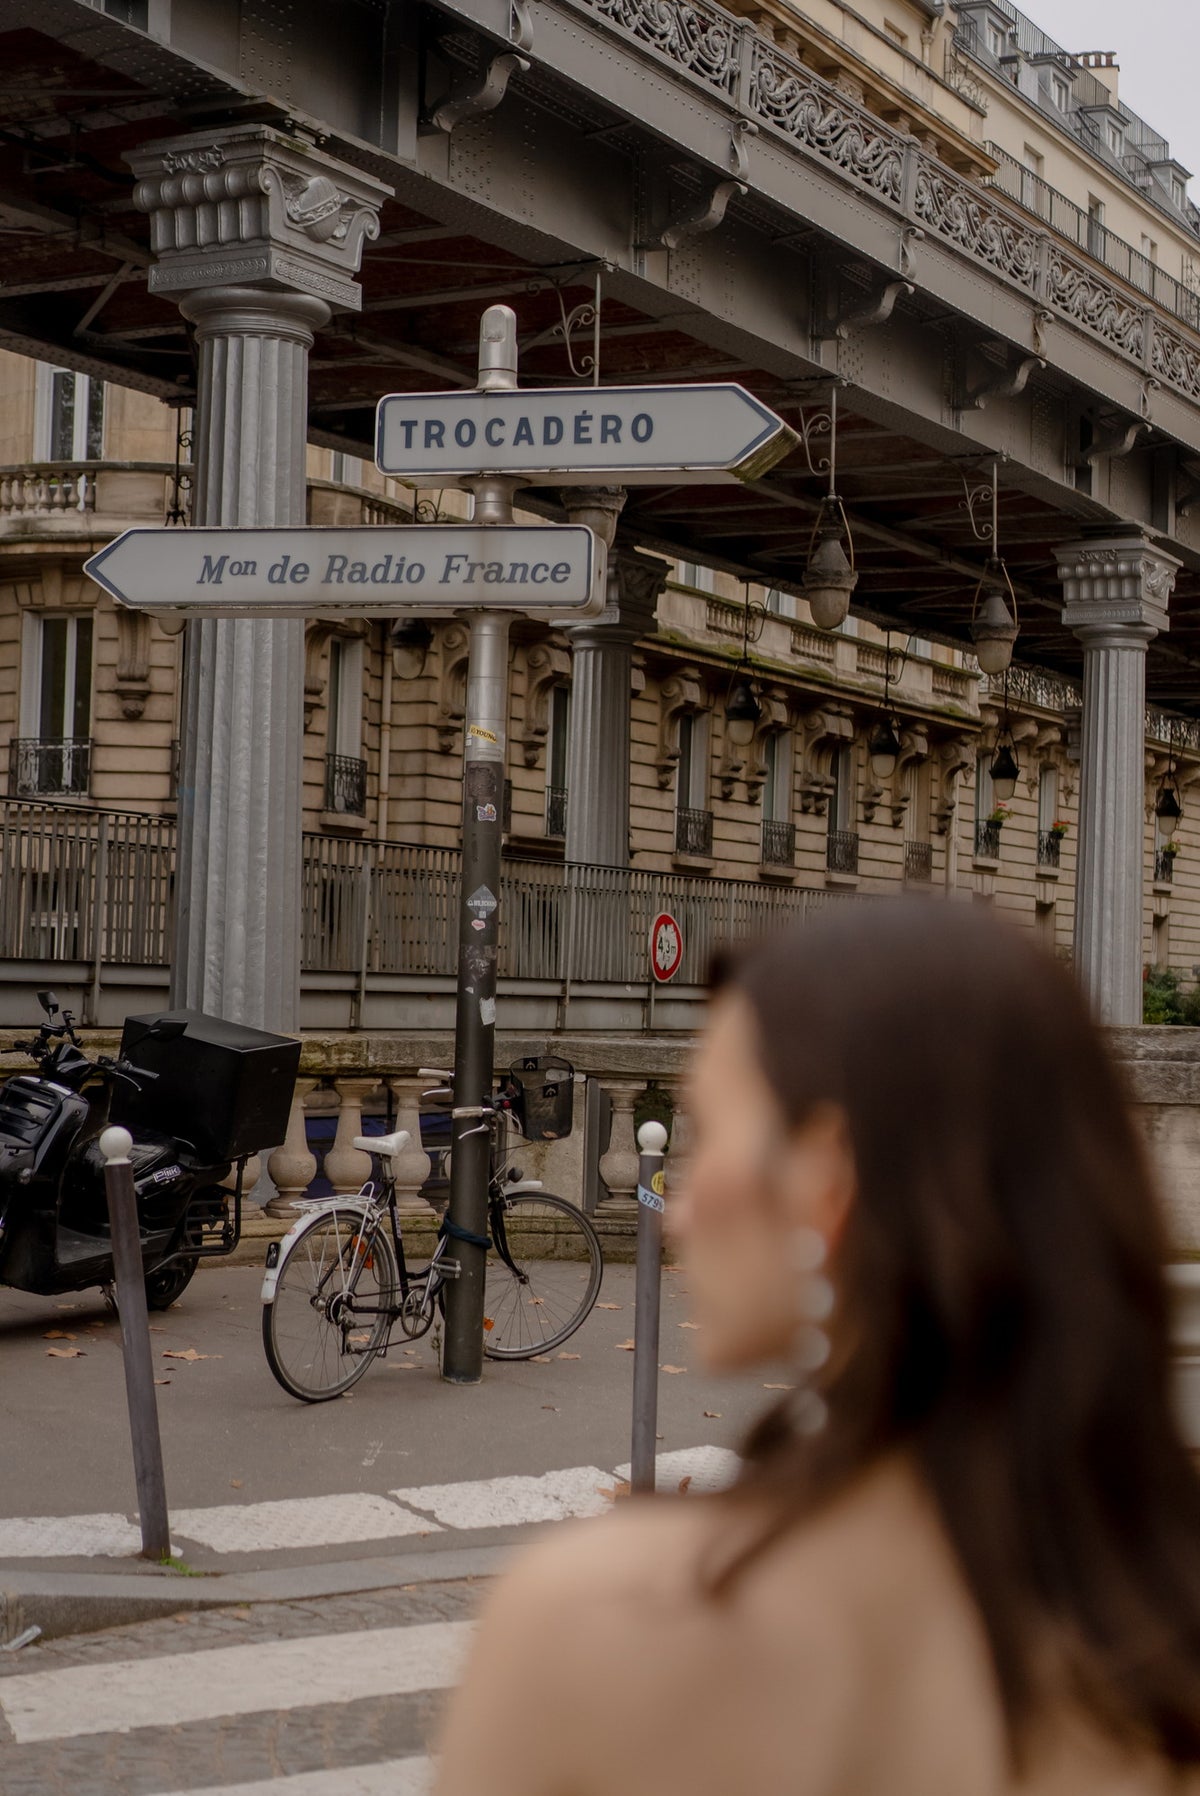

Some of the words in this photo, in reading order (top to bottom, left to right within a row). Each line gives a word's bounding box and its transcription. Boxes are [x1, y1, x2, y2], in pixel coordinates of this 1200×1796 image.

[400, 410, 654, 449] TROCADÉRO
[196, 555, 257, 584] Mon
[267, 555, 310, 584] de
[321, 554, 426, 584] Radio
[438, 554, 571, 584] France
